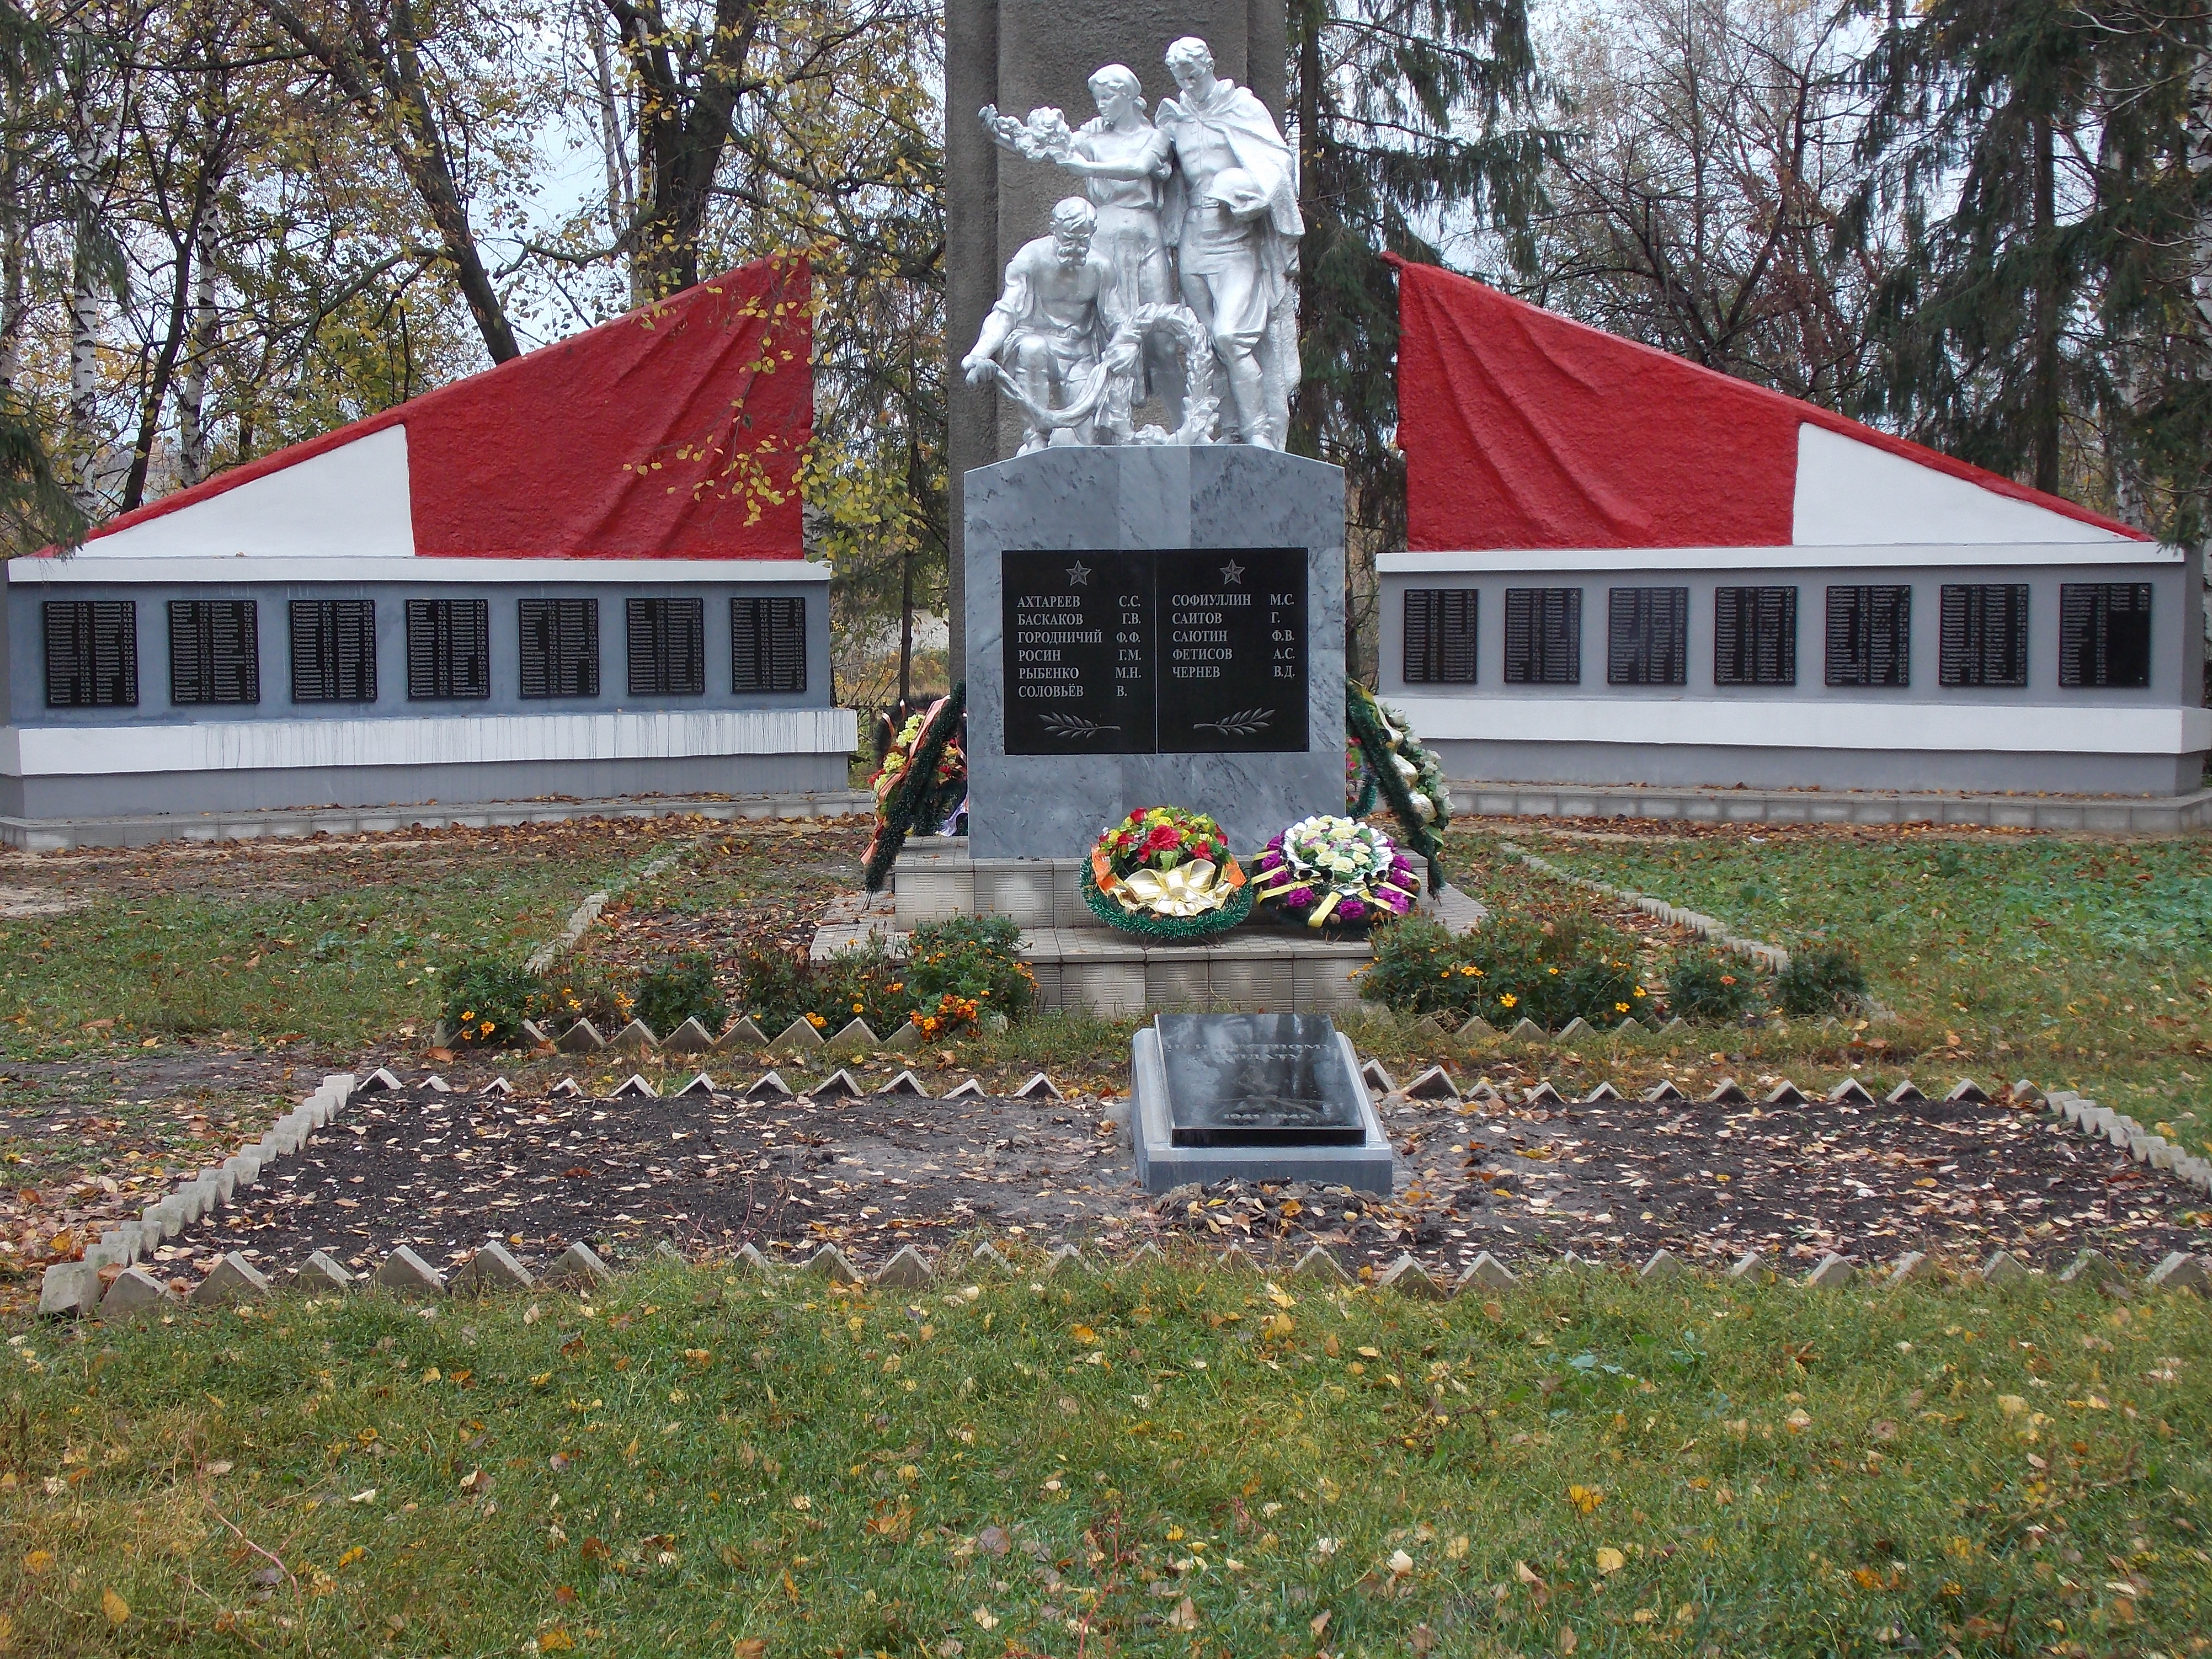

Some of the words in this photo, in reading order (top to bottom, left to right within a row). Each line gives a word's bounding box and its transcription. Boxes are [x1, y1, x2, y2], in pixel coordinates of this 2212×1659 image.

[1017, 596, 1080, 608] АХТАРЕЕВ
[1119, 595, 1141, 607] С.С.
[1172, 594, 1251, 606] СОФИУЛЛИН
[1270, 594, 1294, 605] М.С.
[1017, 613, 1083, 625] БАСКАКОВ
[1122, 613, 1141, 625] Г.В.
[1172, 613, 1222, 624] САИТОВ
[1271, 612, 1280, 623] Г.
[1018, 628, 1102, 645] ГОРОДНИЧИЙ
[1116, 632, 1141, 643] Ф.Ф.
[1173, 630, 1227, 642] САЮТИН
[1272, 630, 1295, 641] Ф.В.
[1019, 649, 1061, 661] РОСИН
[1118, 649, 1142, 661] Г.М.
[1172, 648, 1232, 660] ФЕТИСОВ
[1274, 648, 1295, 659] А.С.
[1019, 667, 1079, 679] РЫБЕНКО
[1115, 667, 1142, 678] М.Н.
[1172, 666, 1220, 678] ЧЕРНЕВ
[1274, 665, 1295, 678] В.Д.
[1018, 683, 1083, 697] СОЛОВЬЁВ
[1117, 685, 1127, 697] В.
